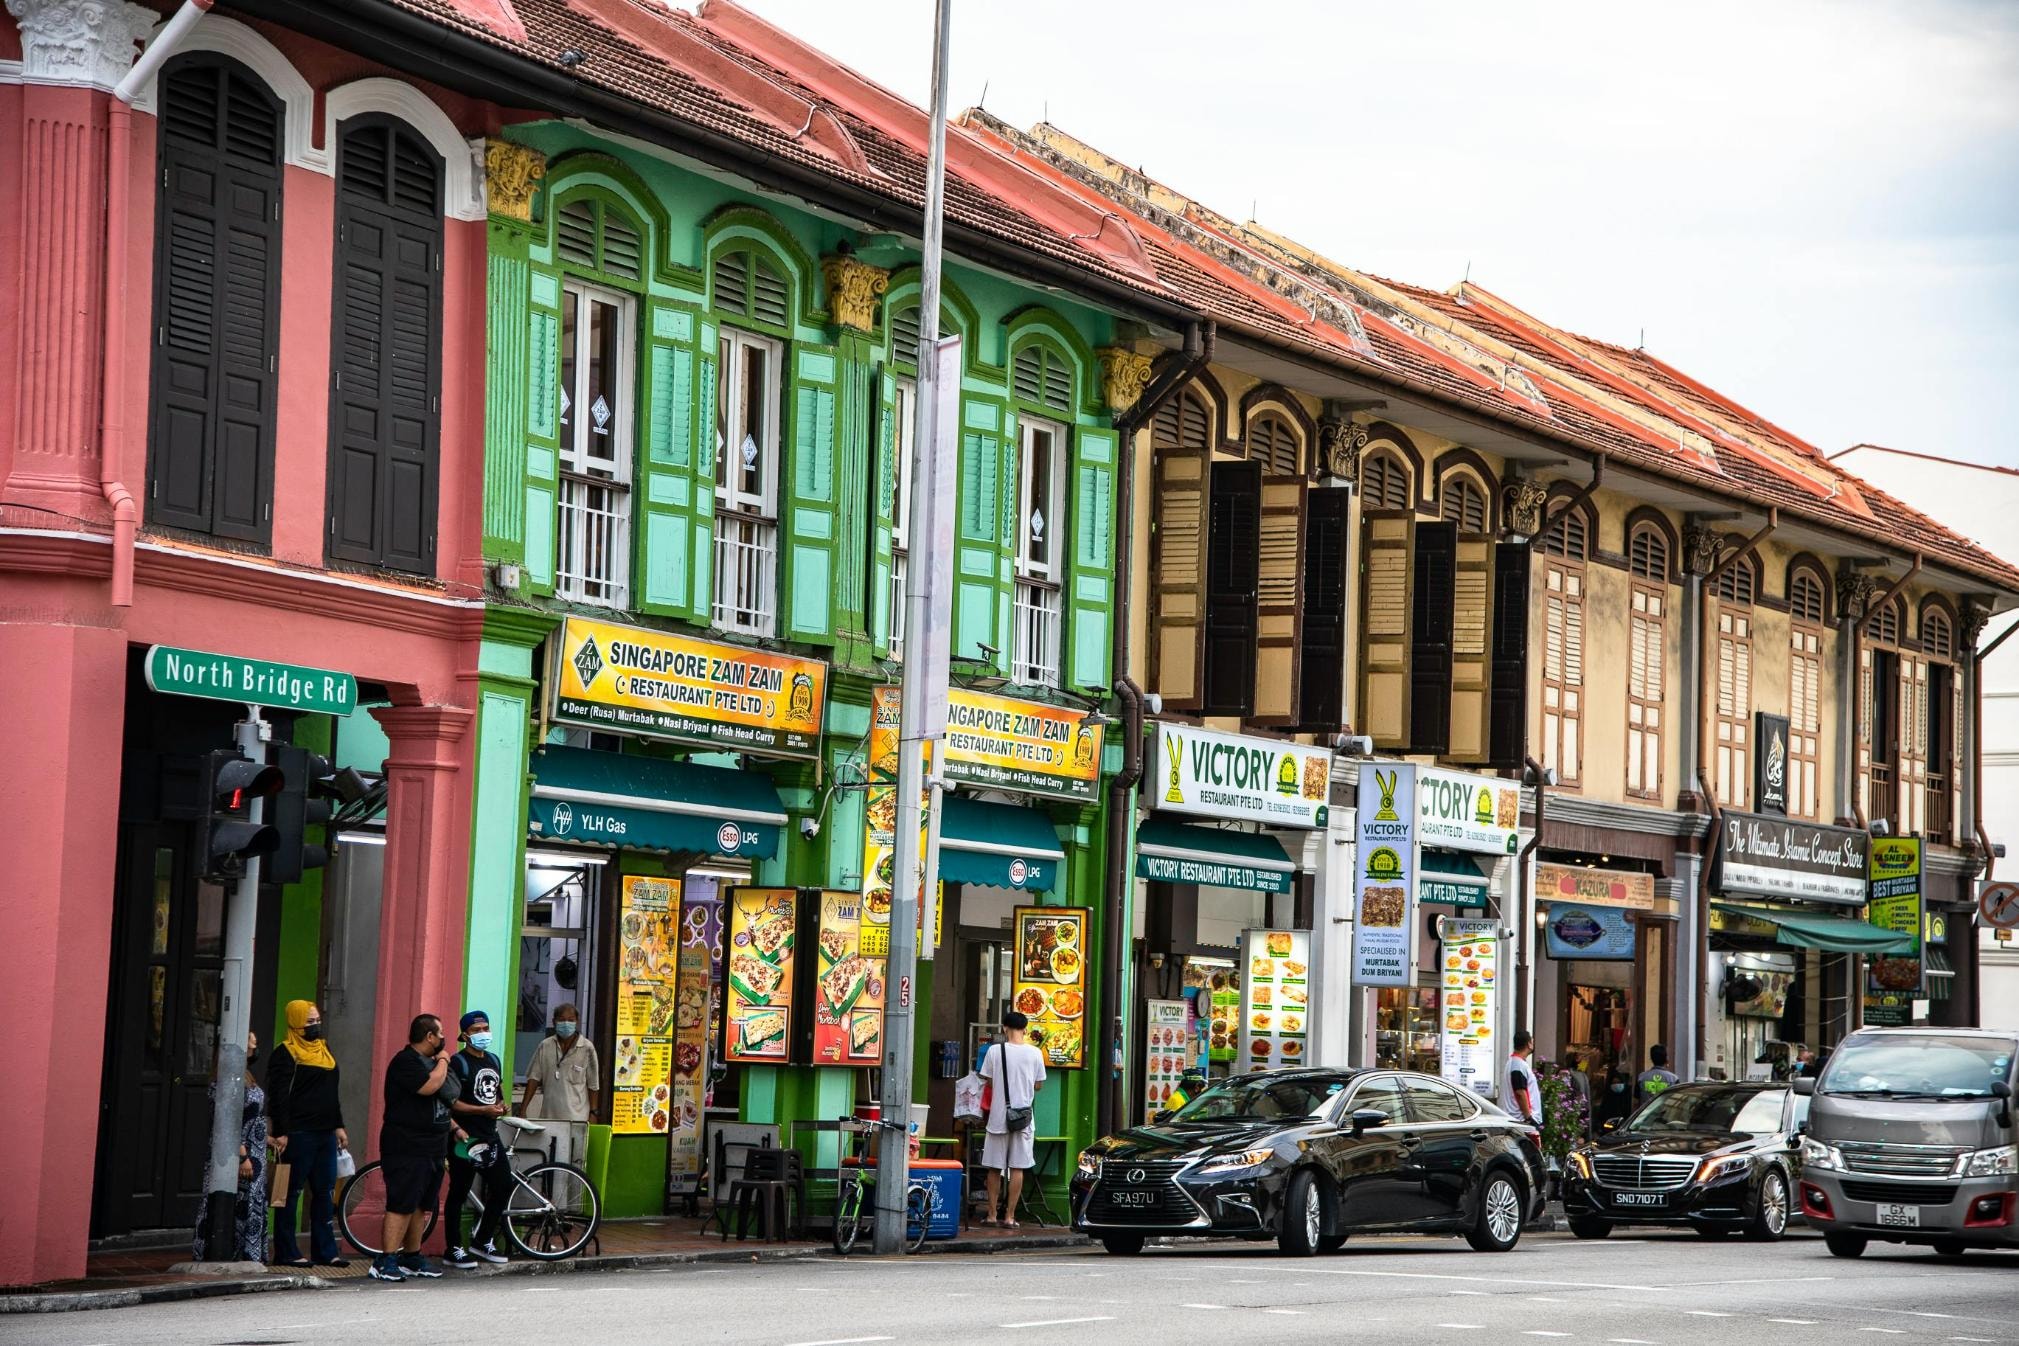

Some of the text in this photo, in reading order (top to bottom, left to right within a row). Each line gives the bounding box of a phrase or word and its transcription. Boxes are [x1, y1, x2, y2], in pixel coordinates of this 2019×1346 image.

[610, 641, 707, 679] SINGAPORE
[711, 659, 745, 686] ZAM
[748, 666, 782, 692] ZAM
[166, 653, 347, 704] North Bridge Rd
[630, 677, 762, 714] RESTAURANT PTE LTD
[569, 703, 588, 715] Deer
[590, 706, 615, 721] (Rusa)
[618, 710, 654, 725] Murtabak
[664, 717, 681, 729] Nasi
[683, 720, 709, 734] Briyani
[717, 725, 733, 737] Fish
[735, 728, 753, 740] Head
[756, 731, 775, 744] Curry
[1013, 715, 1040, 737] ZAM
[1043, 720, 1070, 743] ZAM
[950, 733, 1053, 762] RESTAURANT PTE LTD
[1191, 740, 1275, 791] VICTORY
[976, 766, 989, 777] Nasi
[991, 768, 1011, 781] Briyani
[1018, 772, 1030, 783] Fish
[1032, 775, 1046, 786] Head
[1048, 778, 1063, 790] Curry
[1200, 790, 1240, 808] RESTAURANT
[1241, 796, 1251, 809] PTE
[1252, 798, 1263, 810] LTD
[582, 814, 603, 831] YLH
[607, 817, 626, 834] Gas
[1363, 824, 1408, 835] VICTORY
[1444, 825, 1453, 837] PTE
[1454, 826, 1463, 838] LTD
[721, 830, 758, 844] Esso LPG
[1727, 820, 1863, 873] The Ultimate Islamic Concept Store
[1888, 845, 1899, 853] AL
[1874, 853, 1915, 862] TASNEEM
[1012, 866, 1040, 877] Esso LPG
[1148, 858, 1254, 887] VICTORY RESTAURANT PTE LTD
[1434, 883, 1445, 900] PTE
[1446, 884, 1457, 901] LTD
[1873, 880, 1892, 898] BEST
[1892, 884, 1917, 895] BRIYANI
[1460, 922, 1493, 930] VICTORY
[1360, 946, 1397, 955] SPECIALISED
[1365, 958, 1400, 967] MURTABAK
[1361, 968, 1402, 977] DUM BRIYANI
[1160, 1006, 1184, 1016] VICTORY
[1112, 1192, 1154, 1204] SFA97U
[1890, 1204, 1905, 1215] GX
